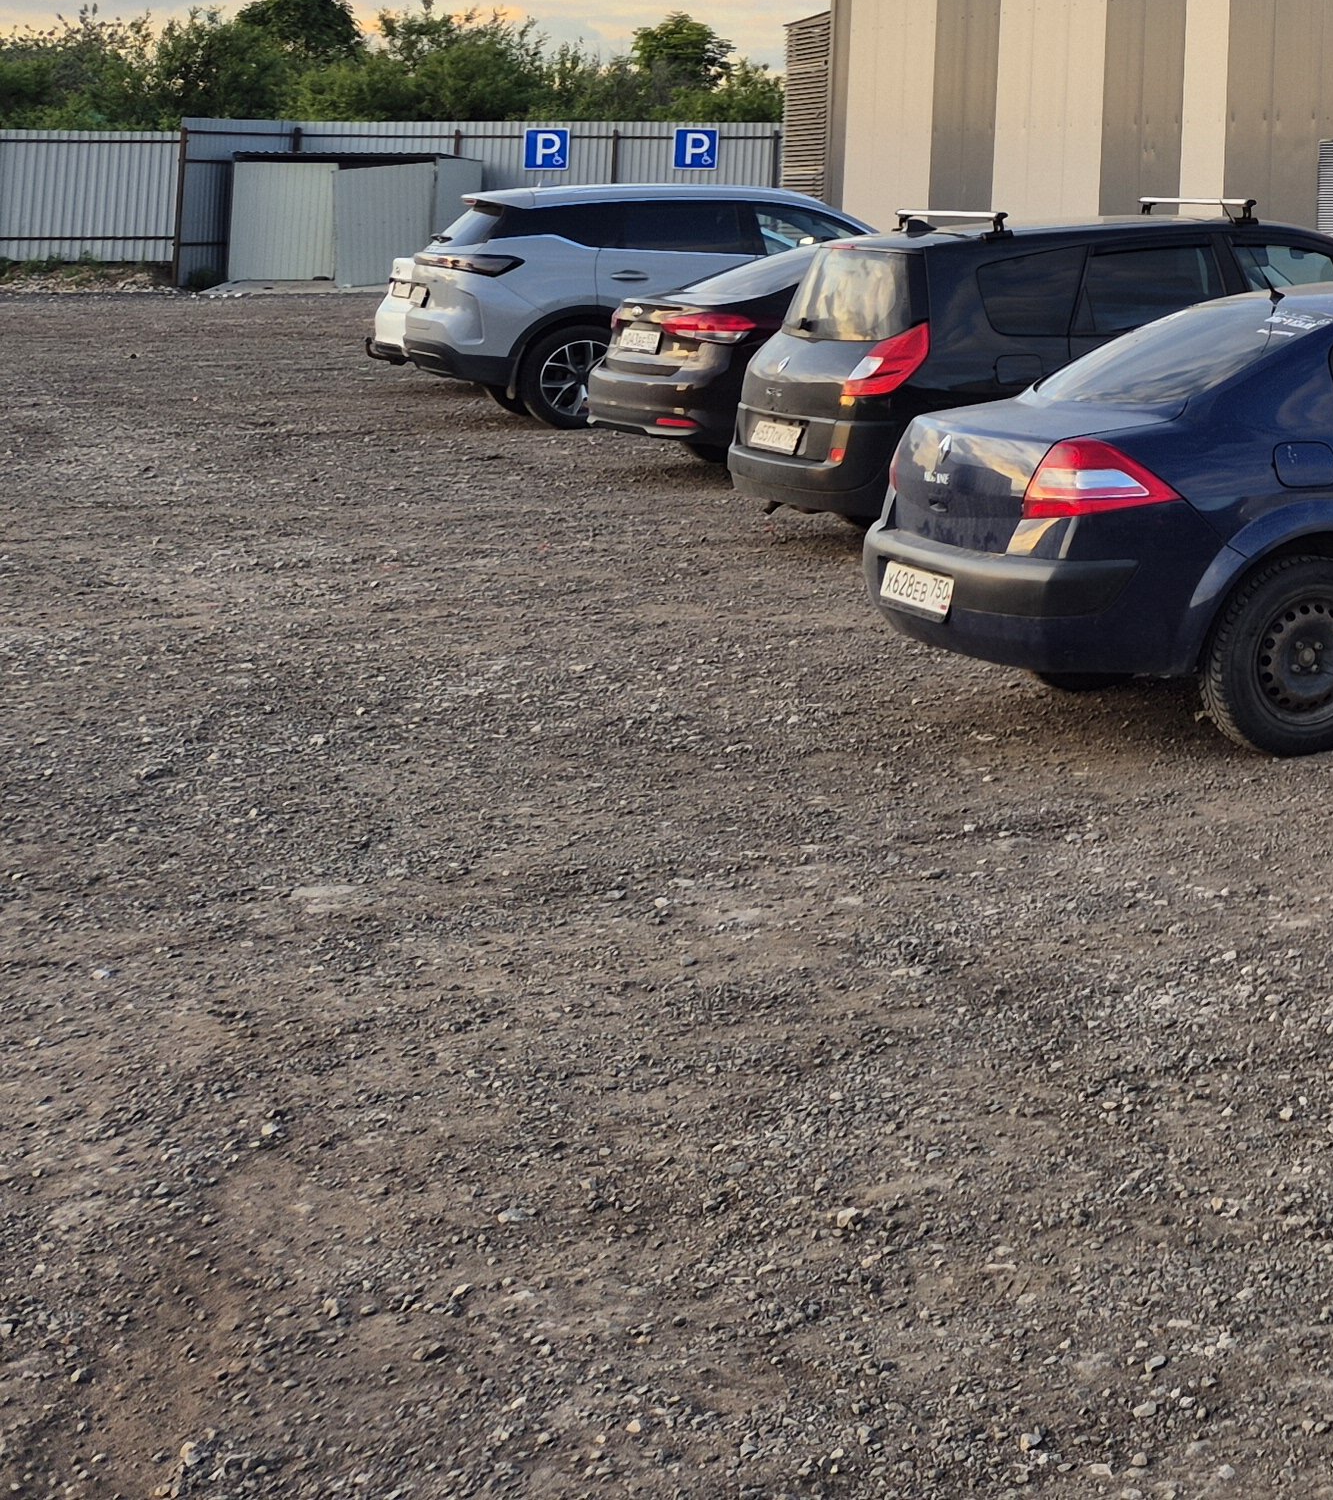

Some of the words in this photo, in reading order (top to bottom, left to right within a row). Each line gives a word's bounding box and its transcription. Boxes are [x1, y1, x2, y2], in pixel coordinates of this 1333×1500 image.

[535, 132, 561, 166] P
[684, 132, 710, 165] P
[930, 577, 950, 601] 750
